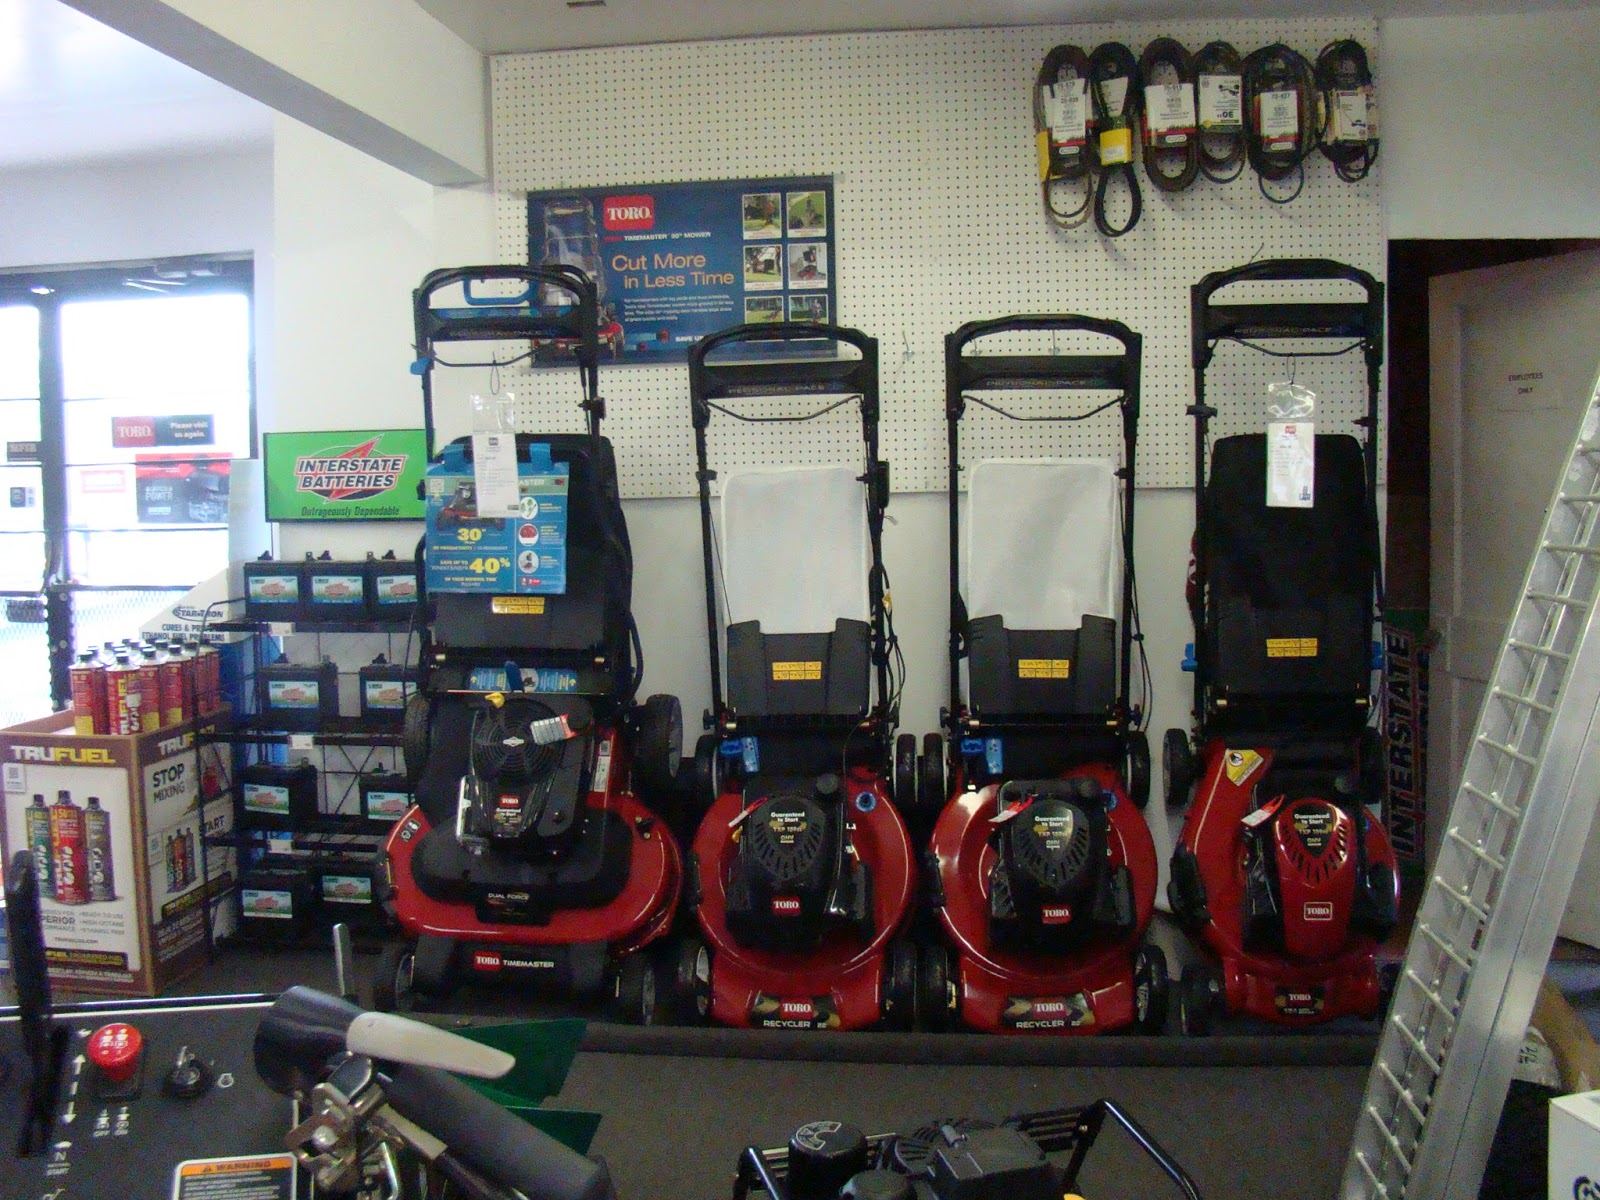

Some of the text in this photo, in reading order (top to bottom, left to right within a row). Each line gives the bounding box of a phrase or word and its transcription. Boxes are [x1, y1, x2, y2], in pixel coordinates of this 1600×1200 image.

[607, 206, 651, 221] TORO
[624, 234, 667, 242] TIMEMASTER
[684, 231, 711, 239] MOWER
[612, 253, 706, 271] Cut More
[624, 271, 735, 289] in Less Time
[170, 421, 193, 429] Please
[119, 425, 152, 438] TORO
[298, 459, 402, 472] INTERSTATE
[302, 474, 395, 488] BATTERIES
[302, 505, 400, 517] Outrageously Dependable
[162, 623, 182, 631] CURES
[142, 631, 170, 640] ETHANOL
[1387, 632, 1415, 853] INTERSTATE
[11, 745, 116, 764] TRUFUEL
[152, 763, 184, 788] STOP
[153, 780, 185, 803] MIXING
[507, 893, 529, 901] FORCE
[773, 900, 799, 909] TORO
[1042, 909, 1069, 918] TORO
[1306, 907, 1330, 915] TORO
[41, 916, 76, 925] PERIOR
[476, 956, 555, 968] TORO TIMEMASTER
[1288, 993, 1311, 1001] TORO
[783, 1003, 811, 1013] TORO
[1034, 1002, 1063, 1012] TORO
[763, 1020, 811, 1028] RECYCLER
[1016, 1020, 1065, 1028] RECYCLER
[216, 1160, 271, 1171] WARNING
